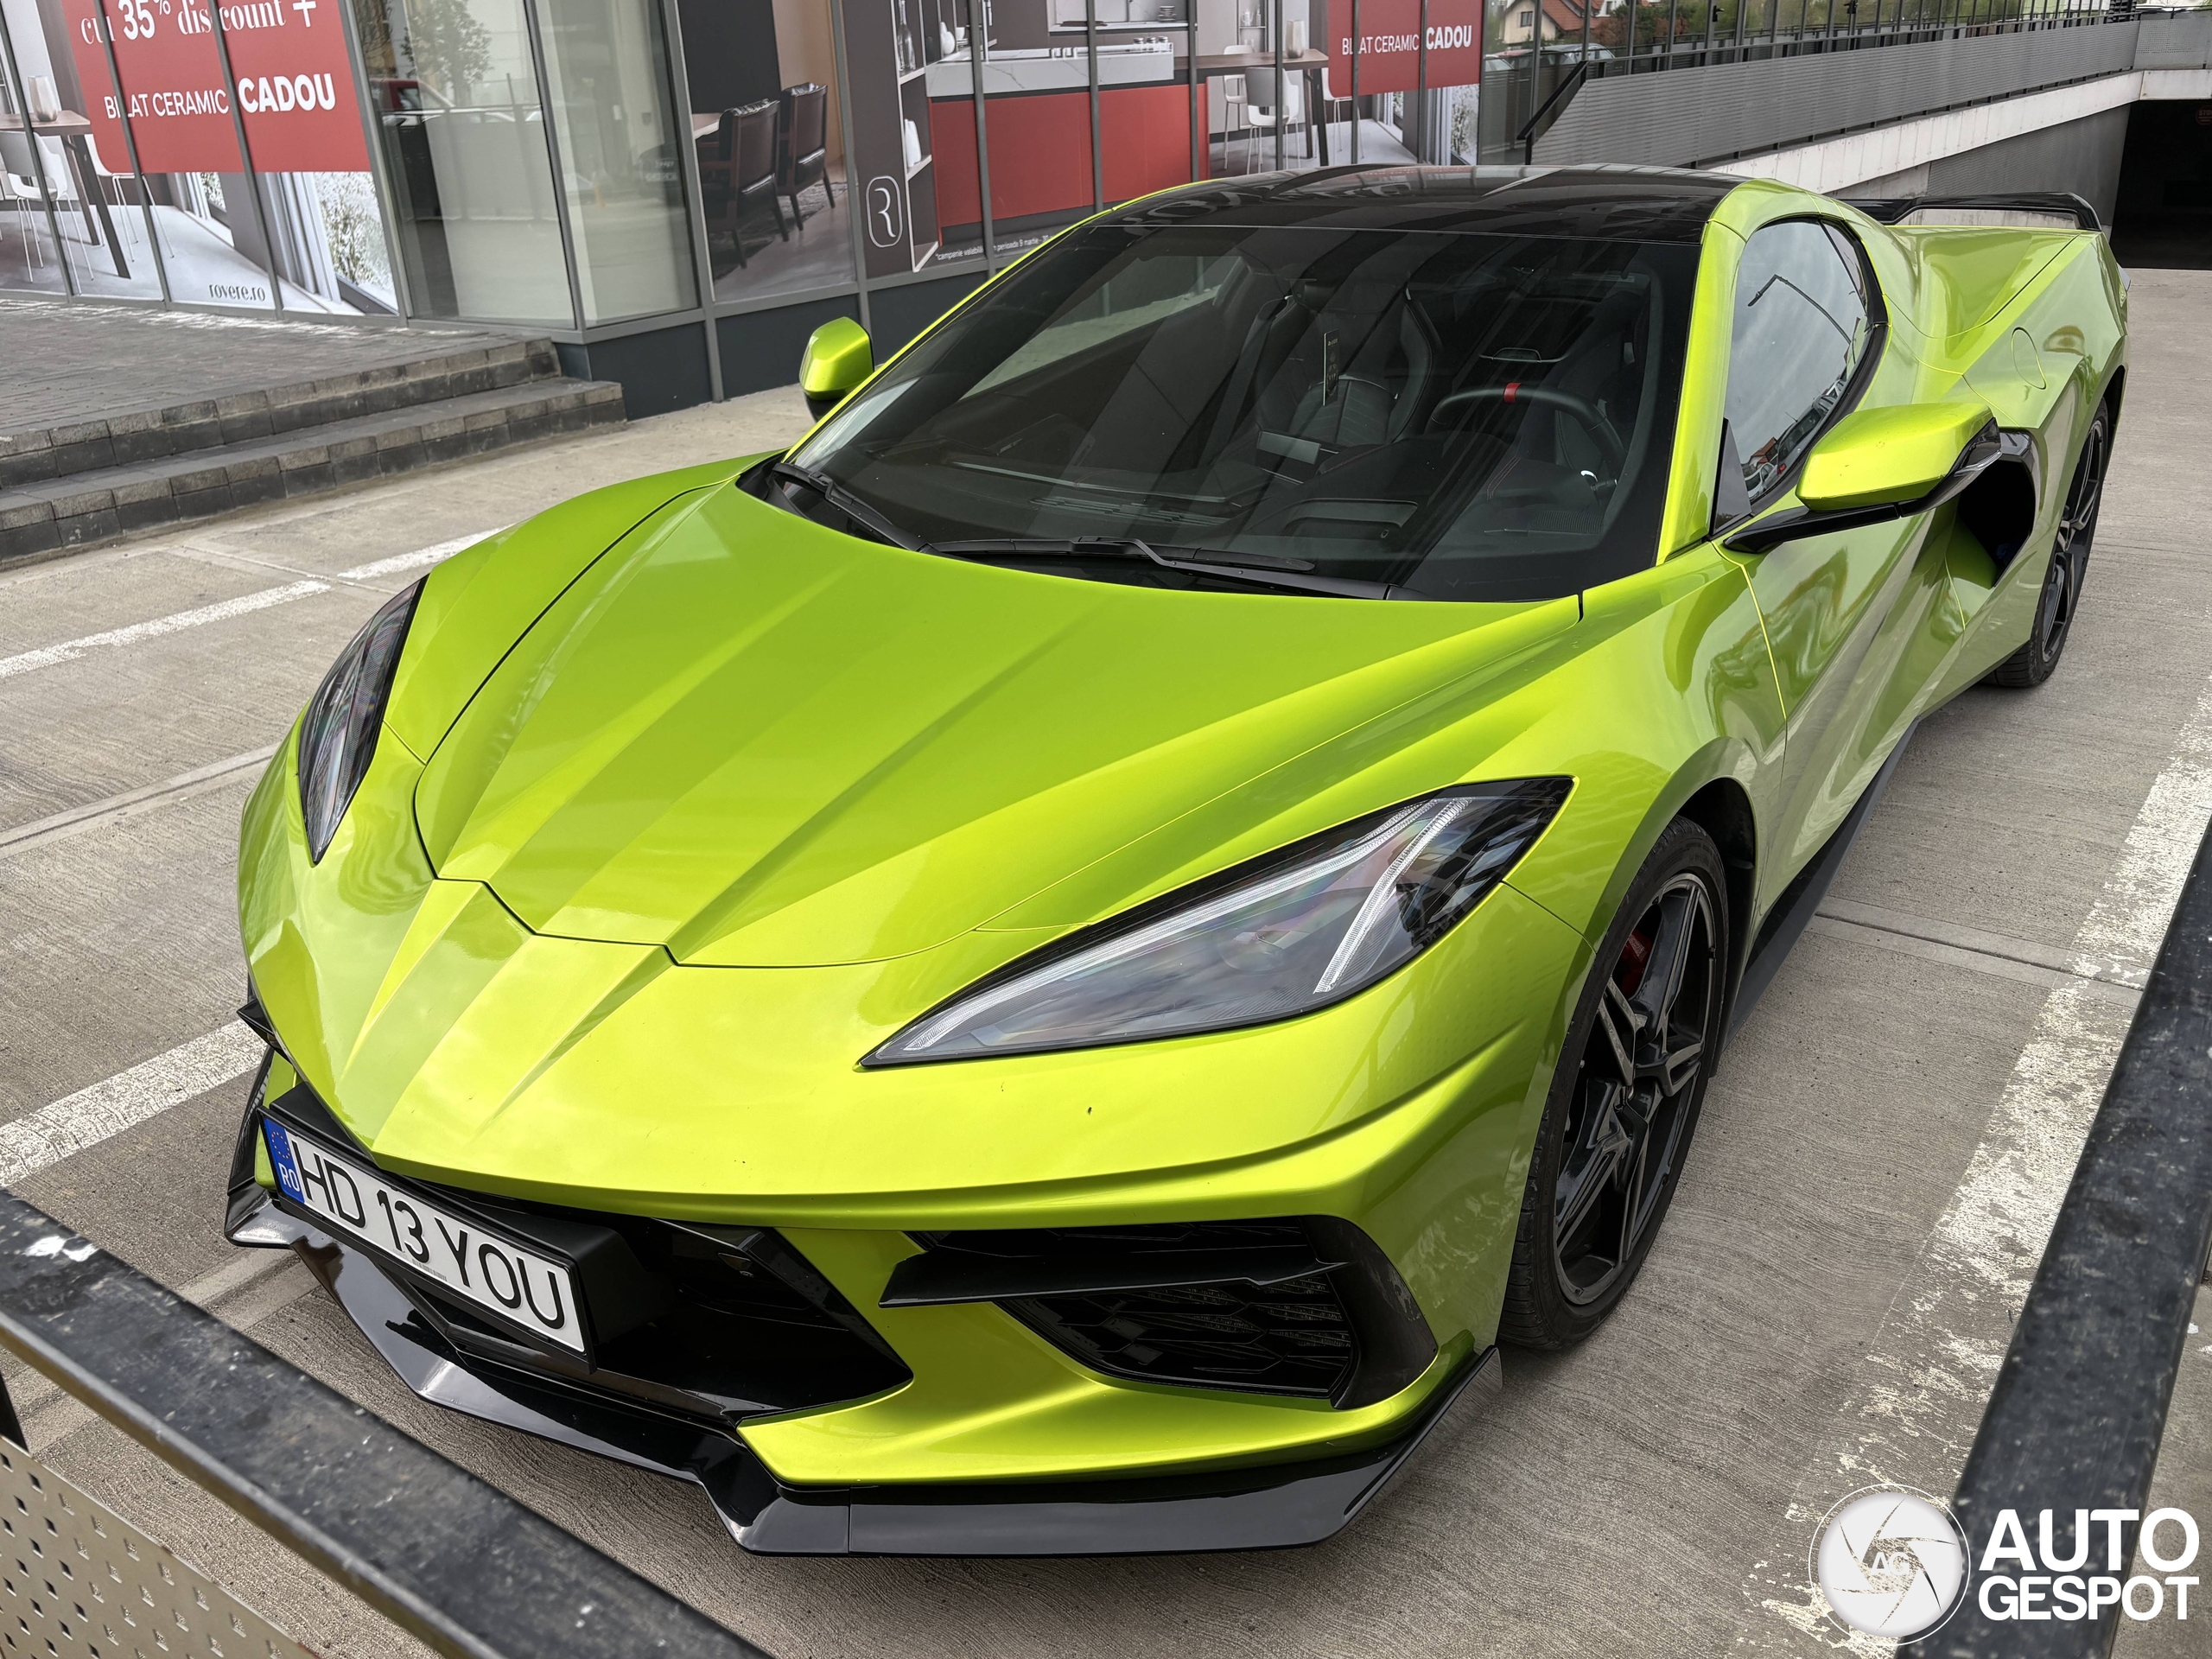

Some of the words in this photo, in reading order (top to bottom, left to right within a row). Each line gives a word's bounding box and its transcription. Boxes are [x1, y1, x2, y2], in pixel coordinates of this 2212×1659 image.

[177, 0, 286, 35] discount
[1374, 34, 1420, 54] CERAMIC
[1426, 25, 1472, 50] CADOU
[152, 89, 229, 116] CERAMIC
[238, 73, 335, 114] CADOU
[208, 284, 266, 302] rovere.ro
[277, 1161, 301, 1193] RO
[291, 1140, 366, 1229] HD
[376, 1188, 430, 1264] 13
[434, 1217, 565, 1330] YOU
